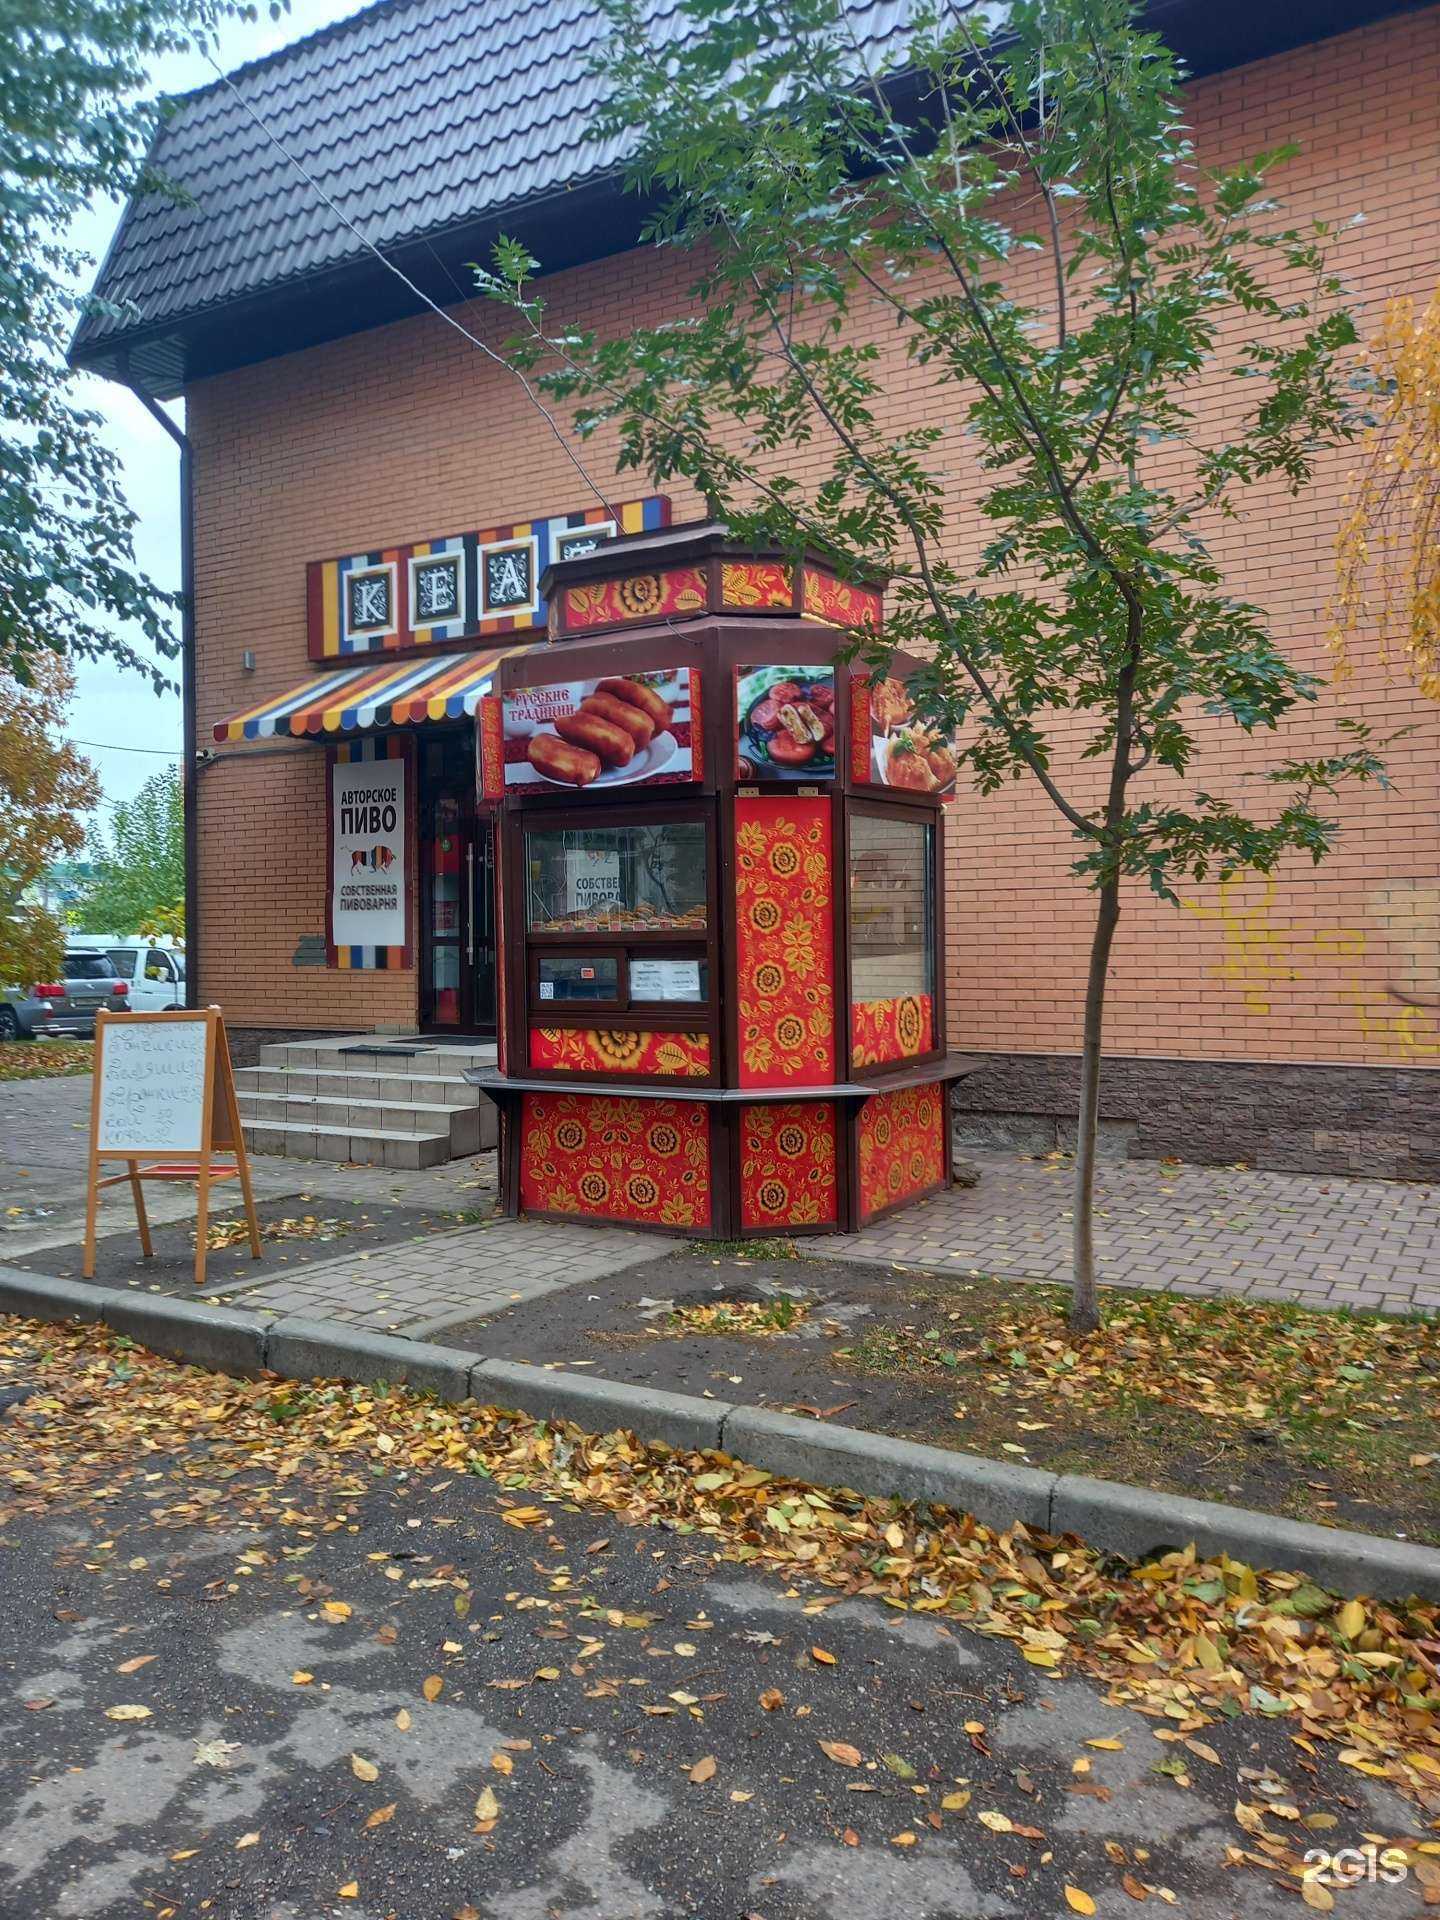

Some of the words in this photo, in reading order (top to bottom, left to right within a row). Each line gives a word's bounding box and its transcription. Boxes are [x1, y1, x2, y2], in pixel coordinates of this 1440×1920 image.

[509, 703, 576, 722] ТРАДИЦИИ
[341, 788, 397, 805] АВТОРСКОЕ
[341, 805, 397, 835] ПИВО
[340, 884, 398, 896] СОБСТВЕННАЯ
[340, 898, 398, 911] ПИВОВАРНЯ
